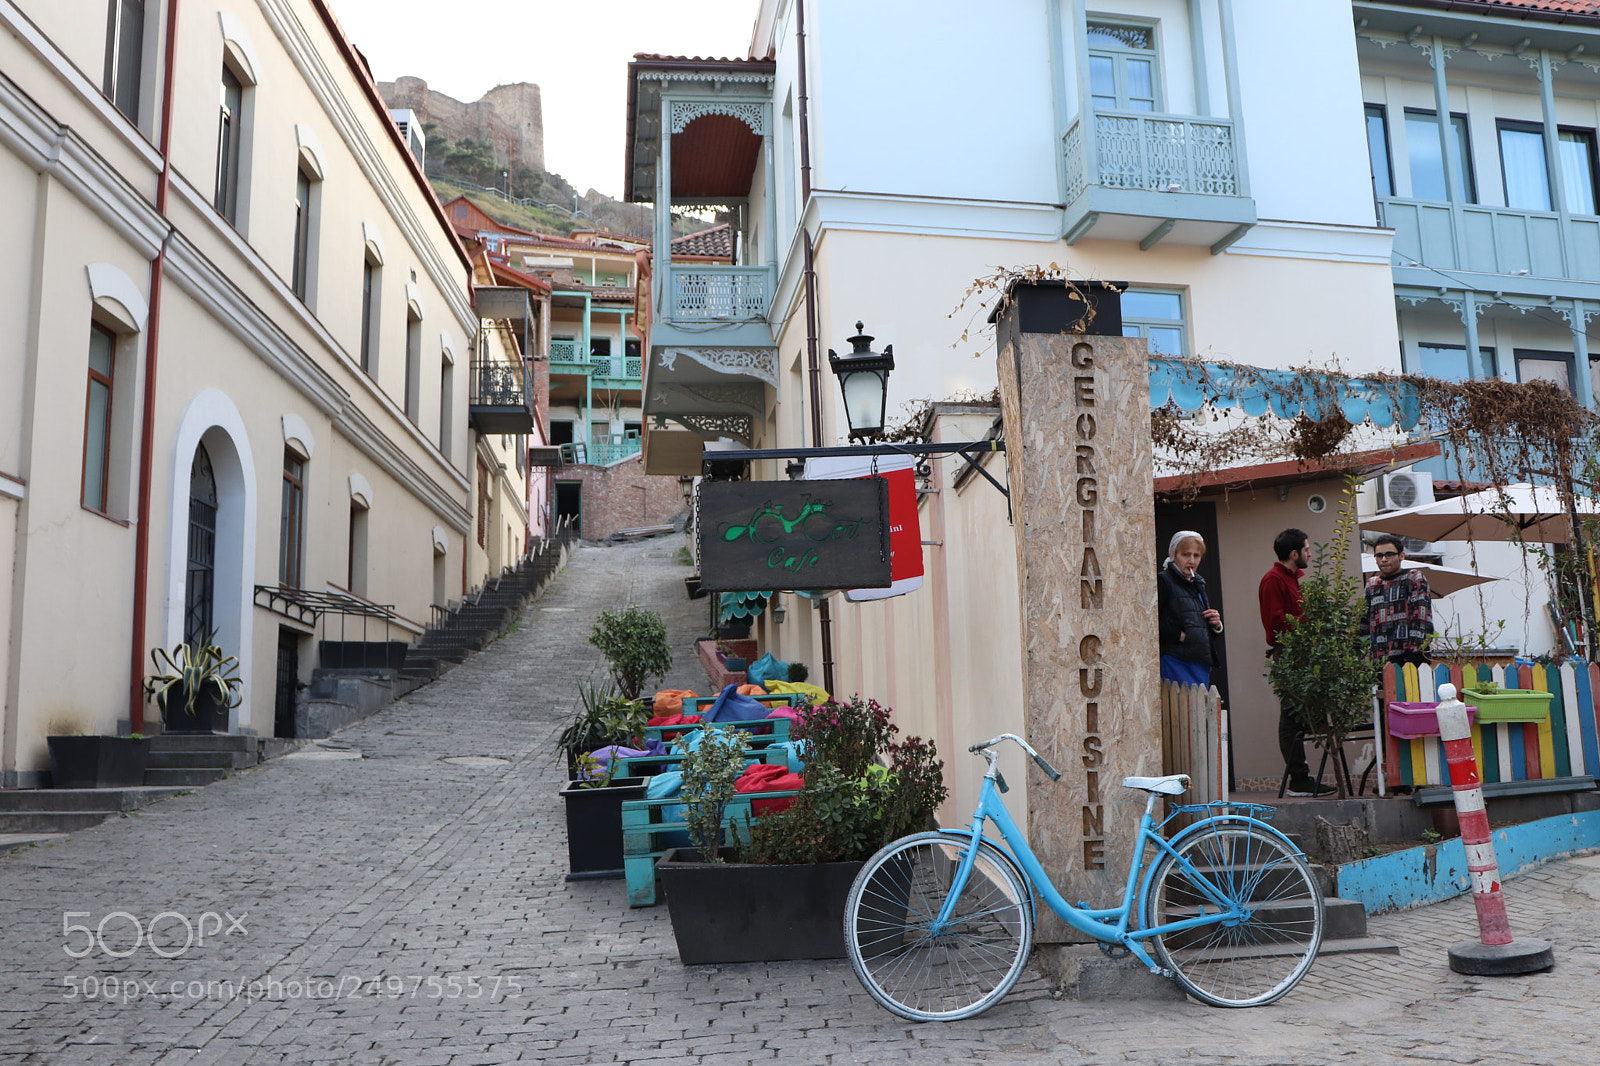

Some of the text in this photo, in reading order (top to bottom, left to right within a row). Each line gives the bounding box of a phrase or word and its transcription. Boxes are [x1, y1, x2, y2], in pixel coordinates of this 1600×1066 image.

[767, 546, 819, 574] Cafe
[1071, 342, 1105, 871] GEORGIAN CUISINE
